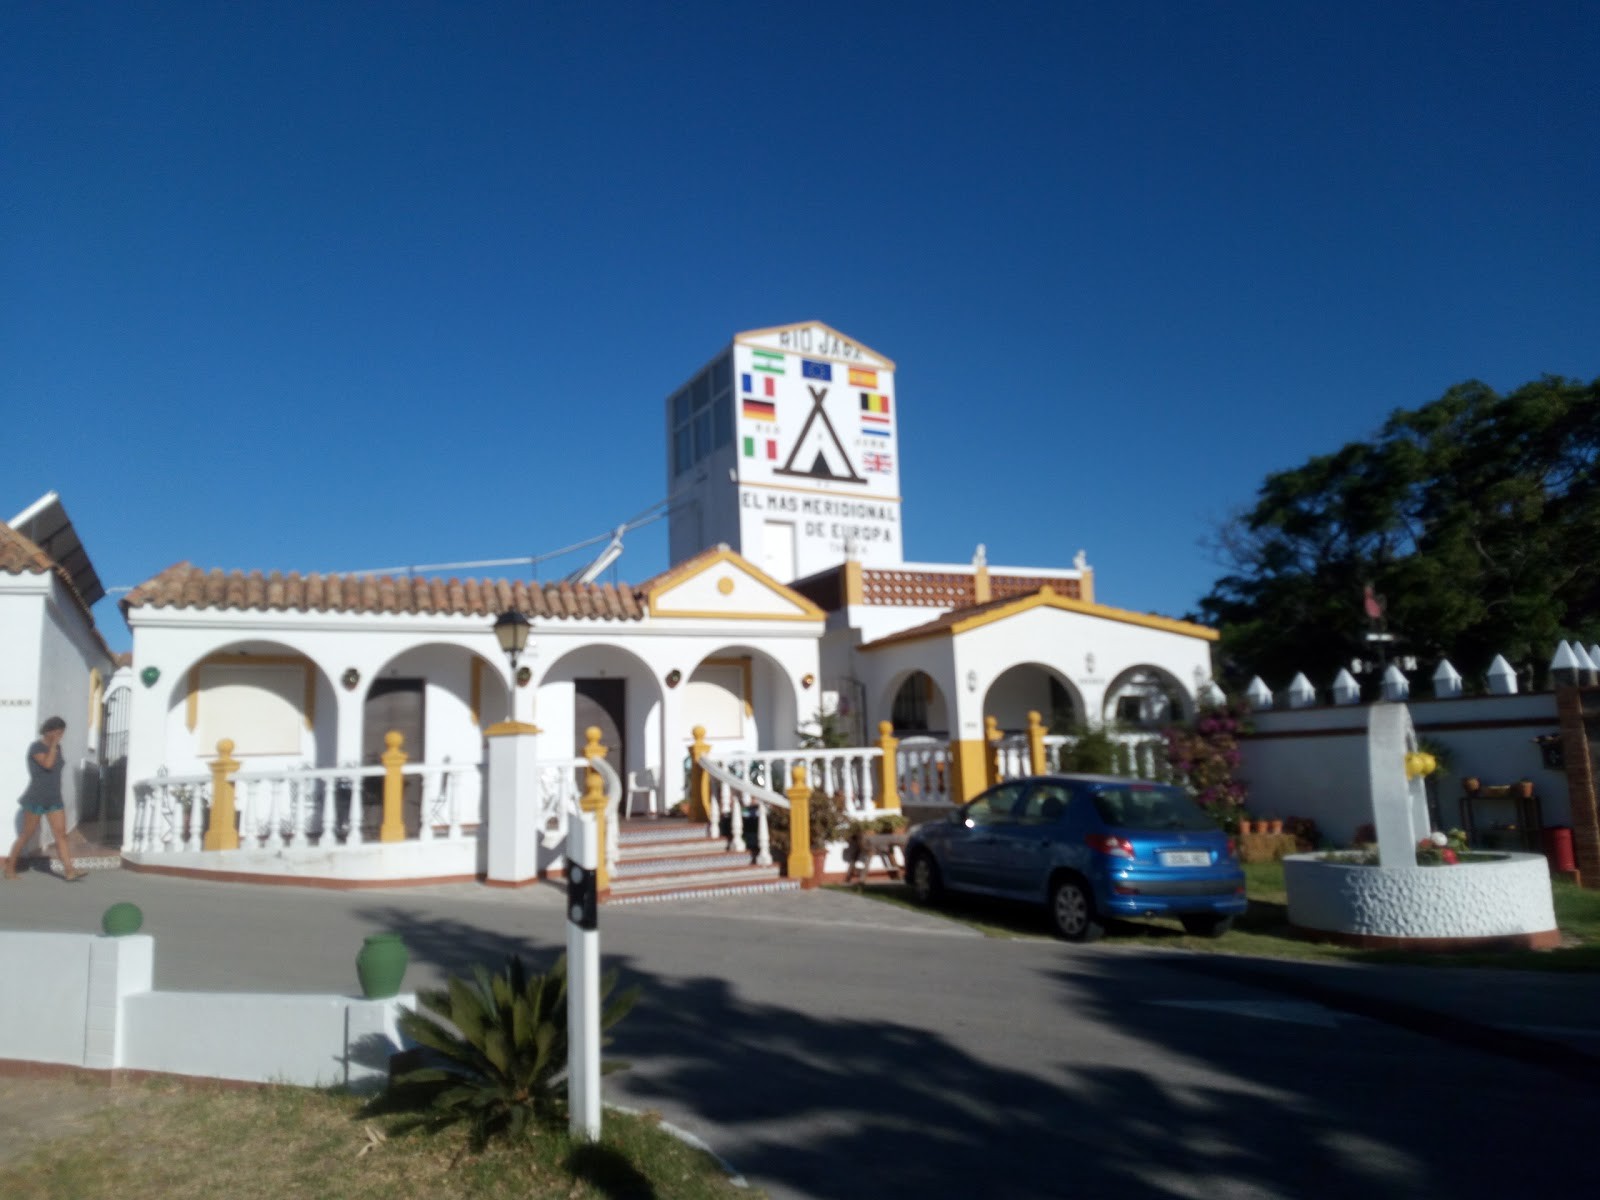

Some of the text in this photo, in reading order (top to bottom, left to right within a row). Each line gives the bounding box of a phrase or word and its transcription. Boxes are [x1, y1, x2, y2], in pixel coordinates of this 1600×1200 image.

[742, 492, 895, 521] EL MAS MERIDIONAL
[805, 521, 891, 542] DE EUROPA
